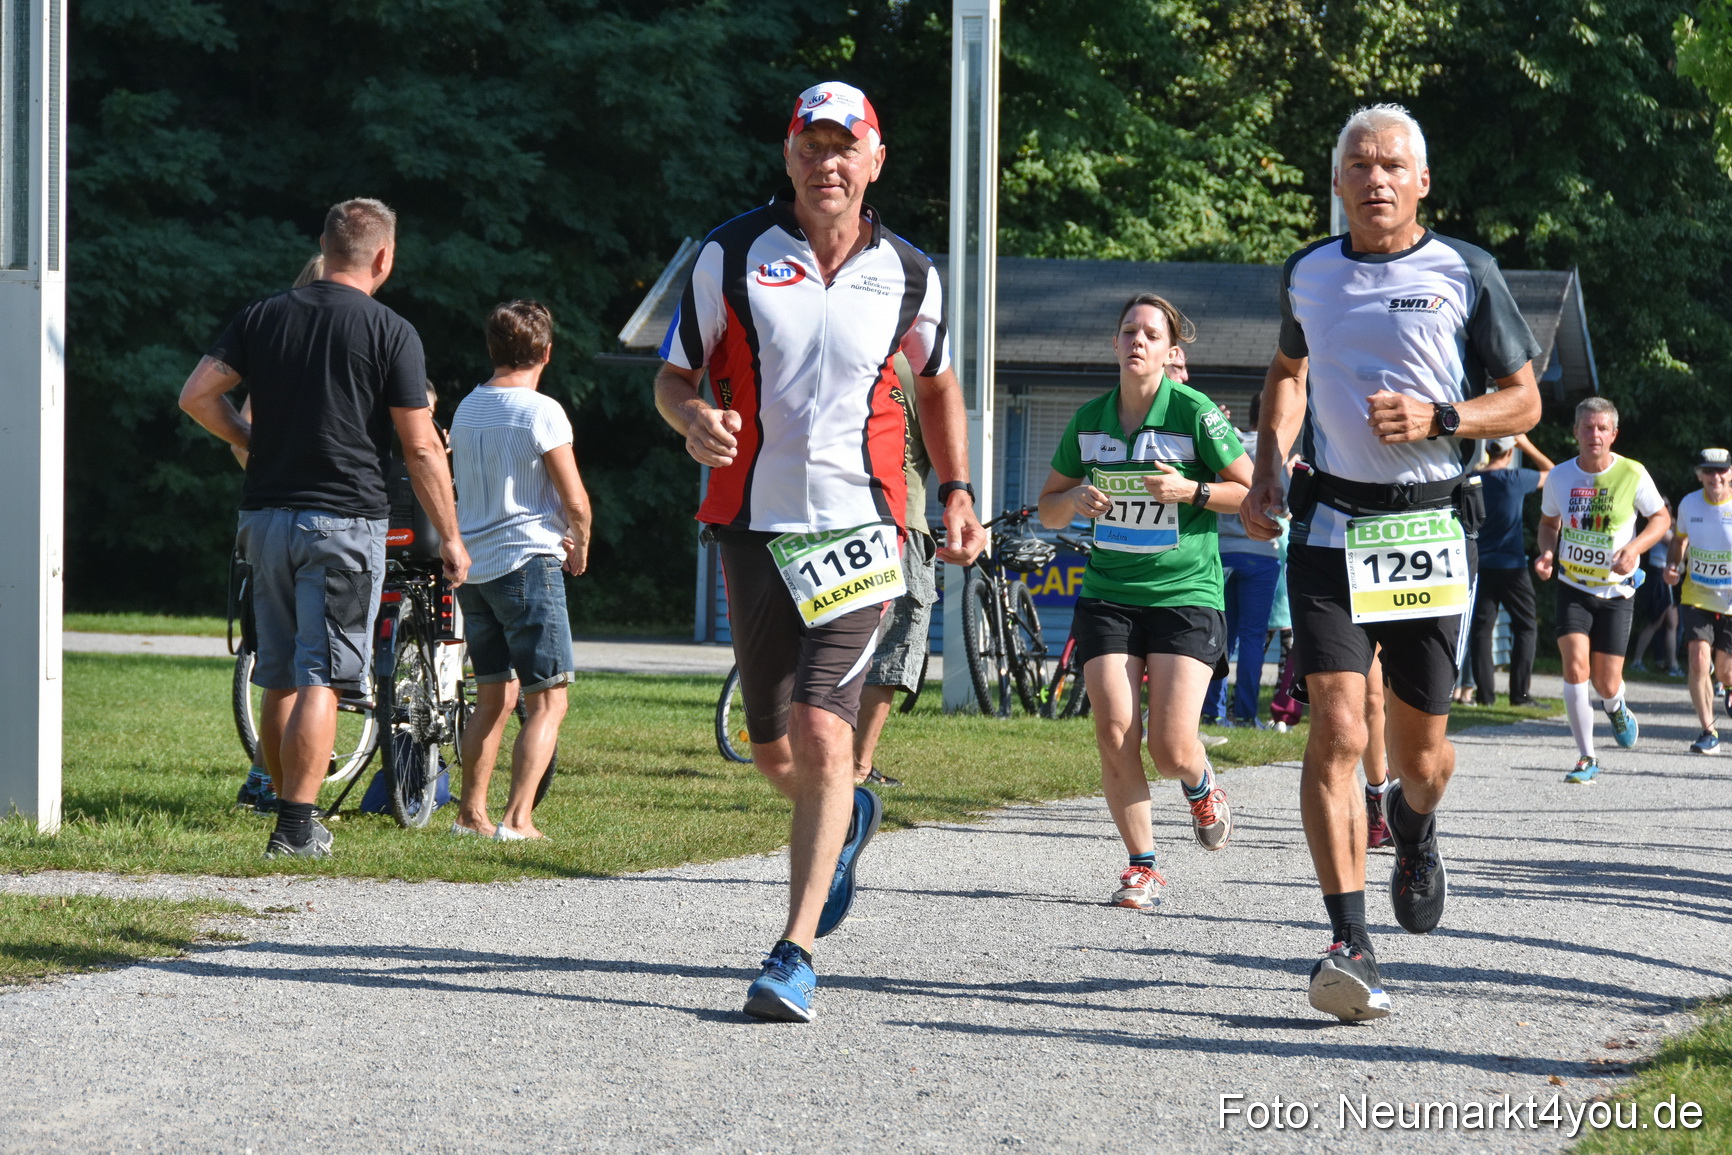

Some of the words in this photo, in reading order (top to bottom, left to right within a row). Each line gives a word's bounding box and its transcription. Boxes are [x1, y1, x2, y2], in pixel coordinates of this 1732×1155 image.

[758, 263, 791, 277] tkn
[860, 274, 878, 282] team
[863, 280, 891, 291] klinikum
[850, 284, 882, 295] nürnberg
[1389, 298, 1429, 309] swn
[1099, 477, 1146, 492] BOC
[1568, 503, 1613, 513] MARATHON
[1569, 496, 1615, 506] GLETSCHER
[1104, 500, 1165, 525] 2777
[1357, 519, 1452, 542] BOCK
[1569, 531, 1608, 546] BOCK
[799, 529, 890, 588] 1181
[1567, 545, 1606, 566] 1099
[1362, 548, 1453, 584] 1291
[1568, 564, 1596, 576] FRANZ
[1694, 560, 1728, 576] 2776
[812, 569, 898, 613] ALEXANDER
[1393, 591, 1431, 607] UDO
